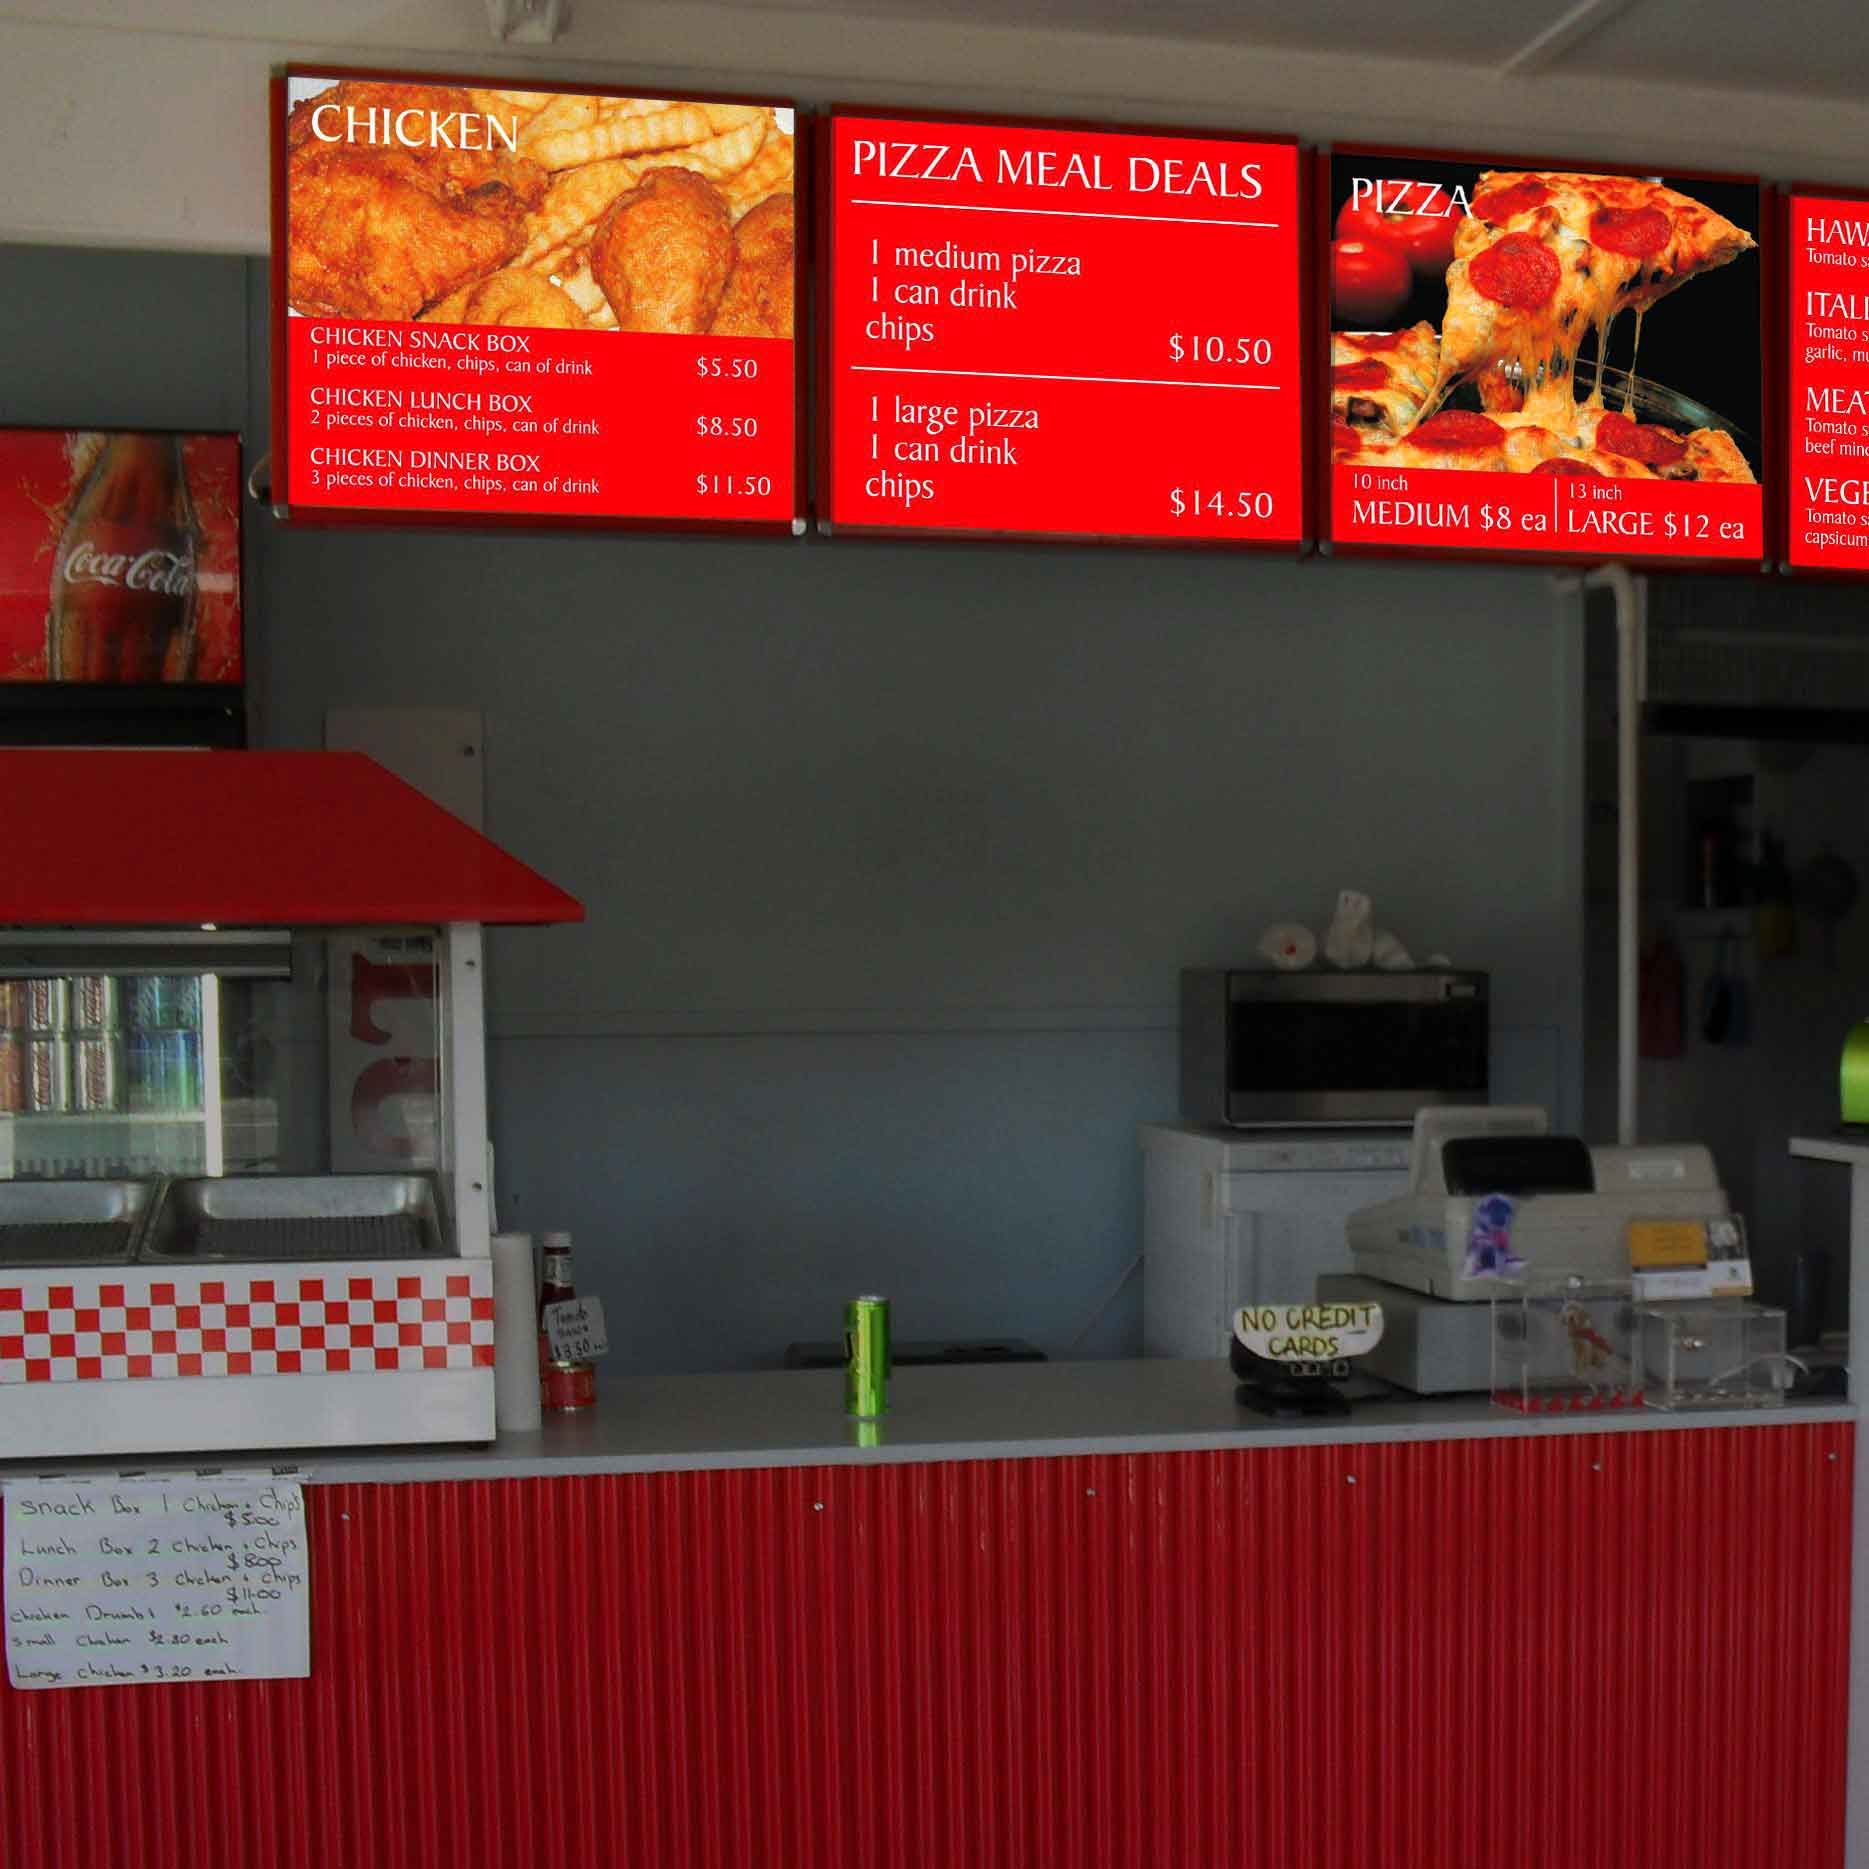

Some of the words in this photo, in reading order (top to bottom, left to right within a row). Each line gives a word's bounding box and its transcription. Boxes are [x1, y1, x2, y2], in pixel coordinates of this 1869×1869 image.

[311, 104, 519, 153] CHICKEN
[853, 140, 983, 182] PIZZA
[997, 149, 1113, 190] MEAL
[1128, 157, 1262, 199] DEALS
[1351, 177, 1474, 219] PIZZA
[1806, 217, 1869, 247] HAW
[895, 240, 1000, 271] medium
[1011, 248, 1081, 283] pizza
[1806, 247, 1857, 268] Tomato
[894, 284, 939, 305] can
[949, 279, 1017, 309] drink
[310, 326, 403, 348] CHICKEN
[409, 330, 481, 351] SNACK
[487, 334, 530, 353] BOX
[865, 311, 934, 351] chips
[1806, 322, 1857, 342] Tomato
[1169, 332, 1272, 365] $10.50
[1804, 343, 1848, 364] garlic,
[314, 349, 318, 364] 1
[326, 351, 366, 369] piece
[371, 351, 387, 366] of
[391, 351, 451, 370] chicken,
[456, 354, 500, 376] chips,
[505, 361, 531, 373] can
[536, 358, 553, 373] of
[555, 359, 592, 375] drink
[697, 355, 758, 378] $5.50
[310, 387, 402, 408] CHICKEN
[410, 391, 481, 411] LUNCH
[489, 394, 532, 413] BOX
[1806, 386, 1869, 415] MEA
[310, 409, 321, 424] 2
[326, 411, 374, 430] pieces
[378, 411, 394, 427] of
[398, 412, 458, 429] chicken,
[463, 415, 506, 436] chips,
[512, 421, 538, 433] can
[543, 417, 559, 433] of
[562, 418, 600, 434] drink
[696, 415, 758, 437] $8.50
[895, 395, 958, 435] large
[969, 402, 1039, 437] pizza
[1806, 417, 1857, 437] Tomato
[894, 442, 939, 462] can
[949, 435, 1017, 465] drink
[1804, 436, 1837, 455] beef
[310, 447, 402, 468] CHICKEN
[410, 450, 491, 471] DINNER
[497, 453, 540, 473] BOX
[311, 469, 320, 485] 3
[326, 471, 374, 490] pieces
[378, 471, 395, 487] of
[398, 472, 458, 489] chicken,
[463, 474, 506, 496] chips,
[512, 480, 538, 492] can
[543, 476, 559, 493] of
[562, 478, 600, 493] drink
[696, 473, 771, 496] $11.50
[865, 469, 935, 508] chips
[1354, 473, 1372, 489] 10
[1377, 474, 1408, 491] inch
[1570, 482, 1587, 499] 13
[1592, 484, 1623, 500] inch
[1170, 487, 1273, 519] $14.50
[1352, 500, 1470, 528] MEDIUM
[1480, 503, 1512, 531] $8
[1521, 513, 1547, 532] ea
[1568, 509, 1654, 536] LARGE
[1664, 511, 1709, 539] $12
[1719, 522, 1745, 540] ea
[1806, 508, 1857, 526] Tomato
[1241, 1307, 1276, 1331] NO
[1286, 1304, 1376, 1331] CREDIT
[1267, 1335, 1339, 1357] CARDS
[111, 1494, 141, 1514] Box
[99, 1536, 133, 1555] Box
[147, 1537, 160, 1555] 2
[100, 1570, 130, 1588] Box
[146, 1571, 160, 1588] 3
